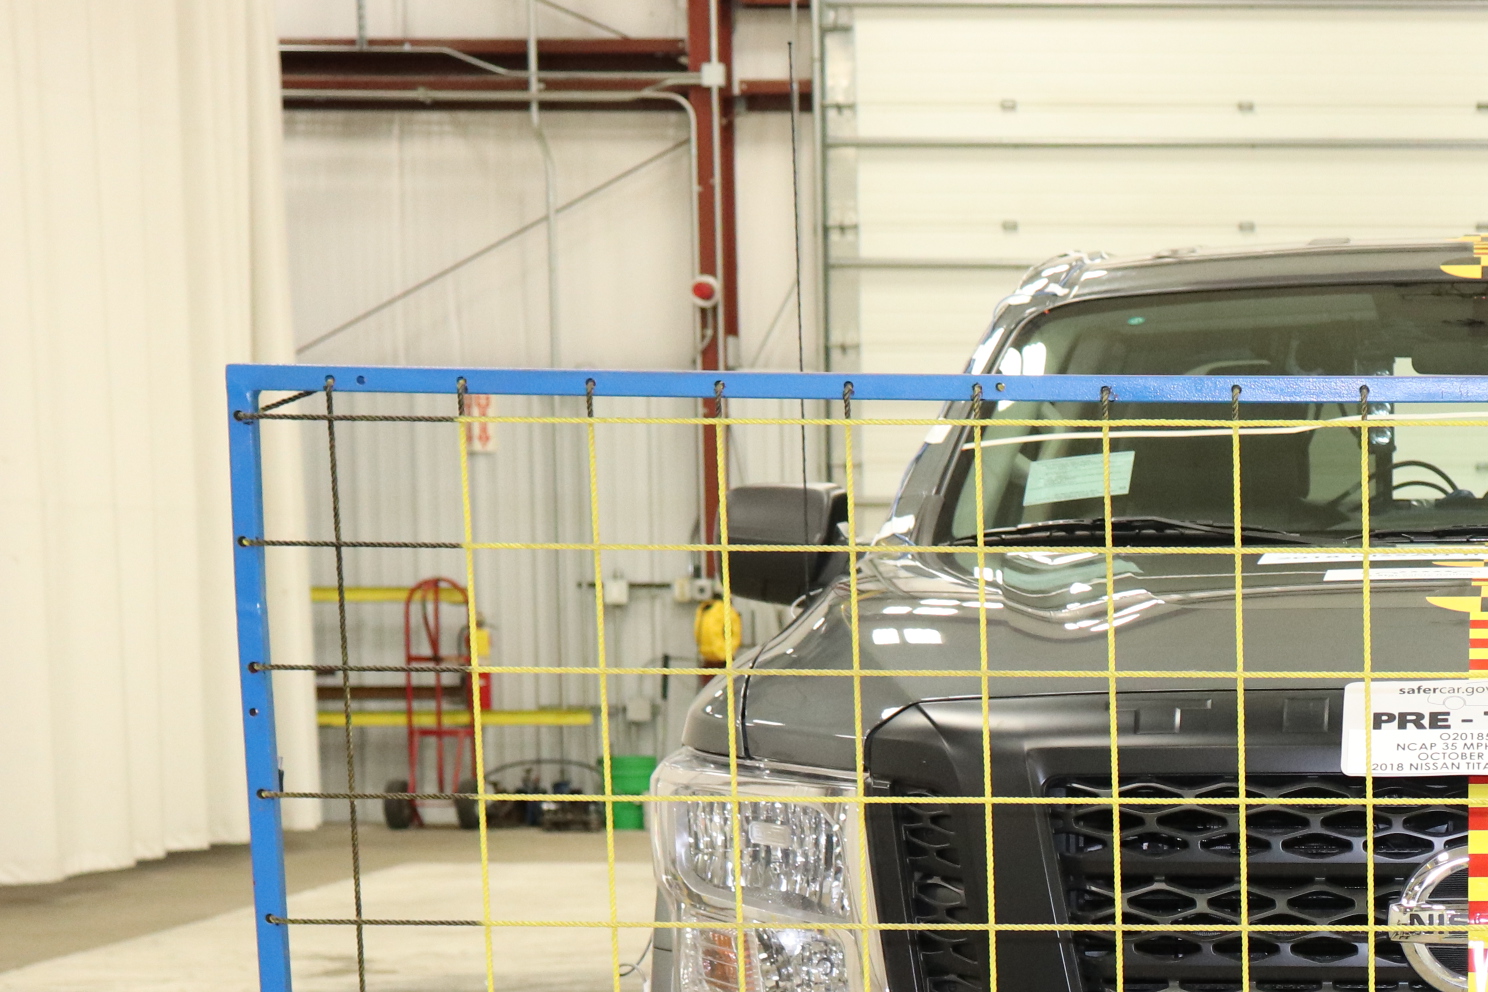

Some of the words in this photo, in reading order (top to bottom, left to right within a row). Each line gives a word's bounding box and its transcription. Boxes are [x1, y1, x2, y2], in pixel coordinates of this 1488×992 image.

[1372, 711, 1451, 730] PRE
[1396, 742, 1437, 751] NCAP
[1441, 742, 1458, 750] 35
[1417, 752, 1484, 761] OCTOBER
[1371, 762, 1404, 771] 2018
[1409, 762, 1460, 771] NISSAN
